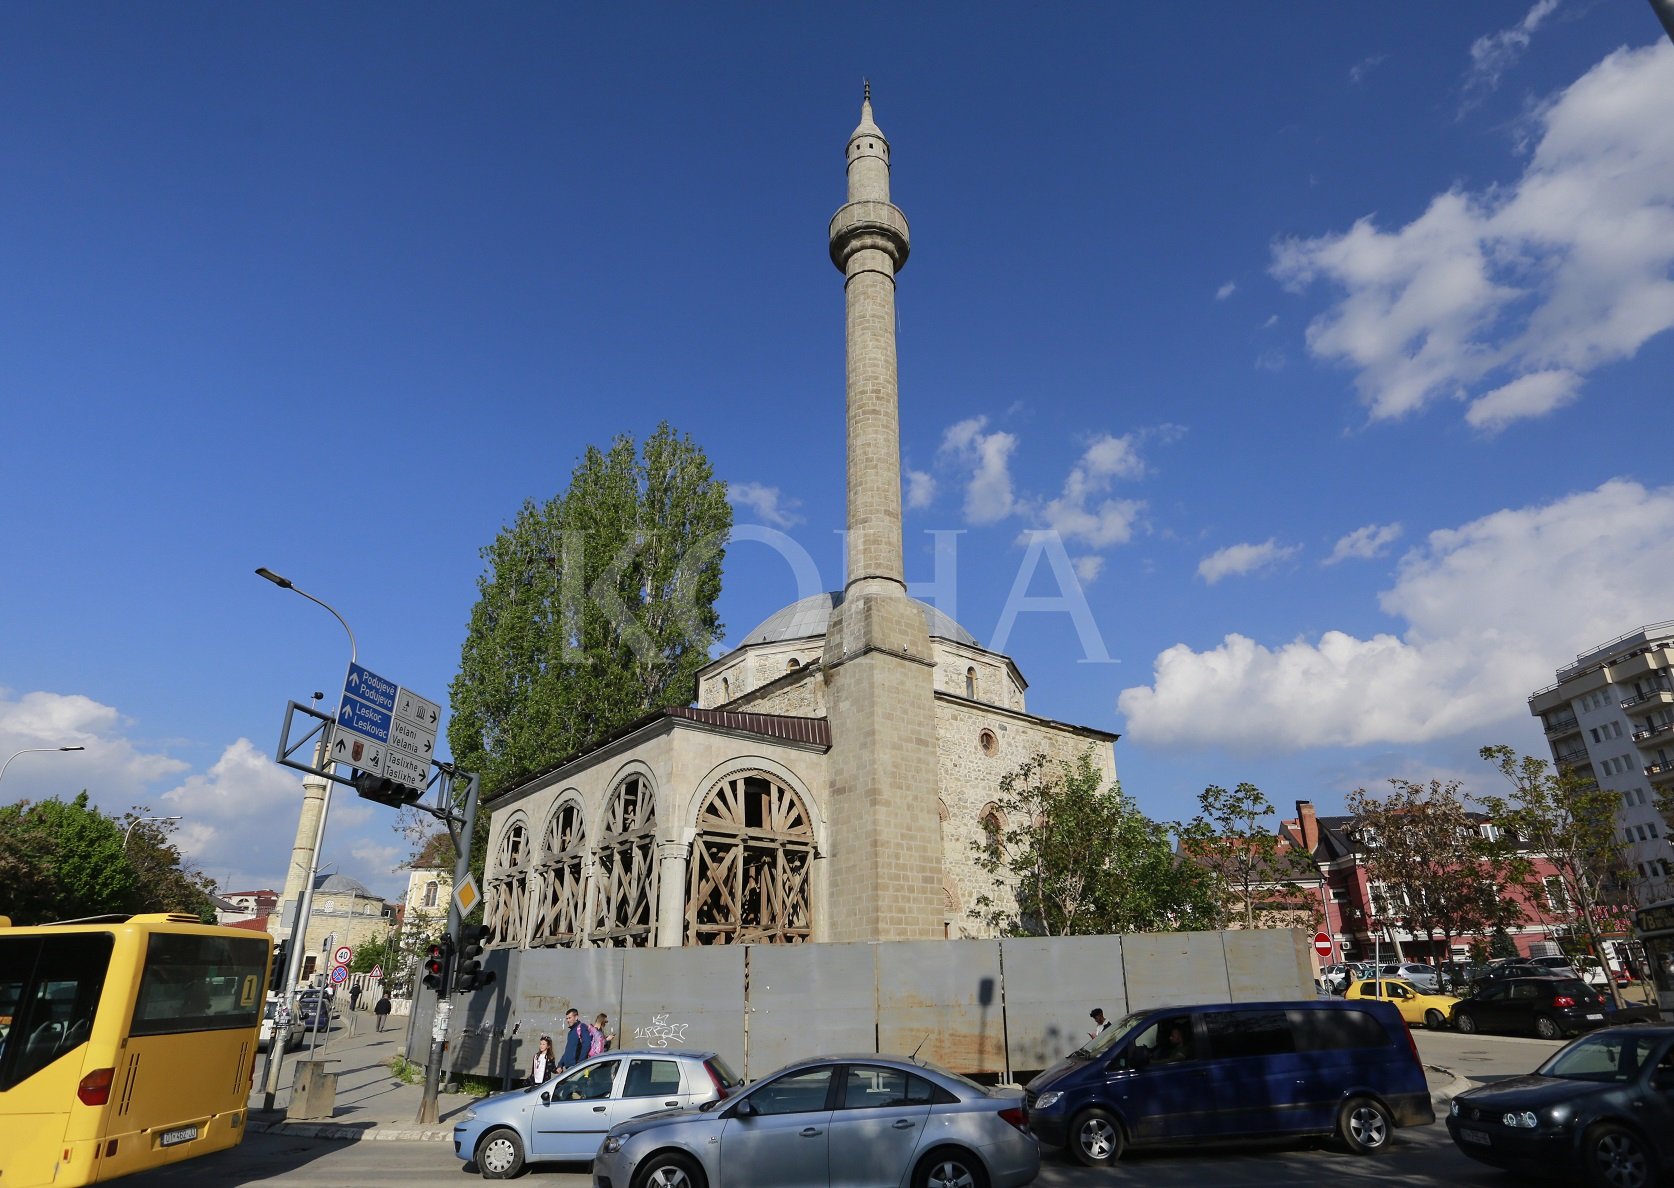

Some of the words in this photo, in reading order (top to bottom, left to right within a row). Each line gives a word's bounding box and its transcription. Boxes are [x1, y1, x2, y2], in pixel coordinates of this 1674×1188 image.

[362, 672, 395, 695] Podujevë
[360, 684, 392, 707] Podujevo
[356, 703, 382, 722] Leskoc
[353, 716, 387, 738] Leskovac
[395, 722, 417, 739] Velani
[392, 735, 418, 753] Velania
[389, 752, 418, 772] Taslixhe
[386, 765, 415, 784] Taslixhe
[338, 951, 349, 960] 40
[244, 978, 254, 1000] 1
